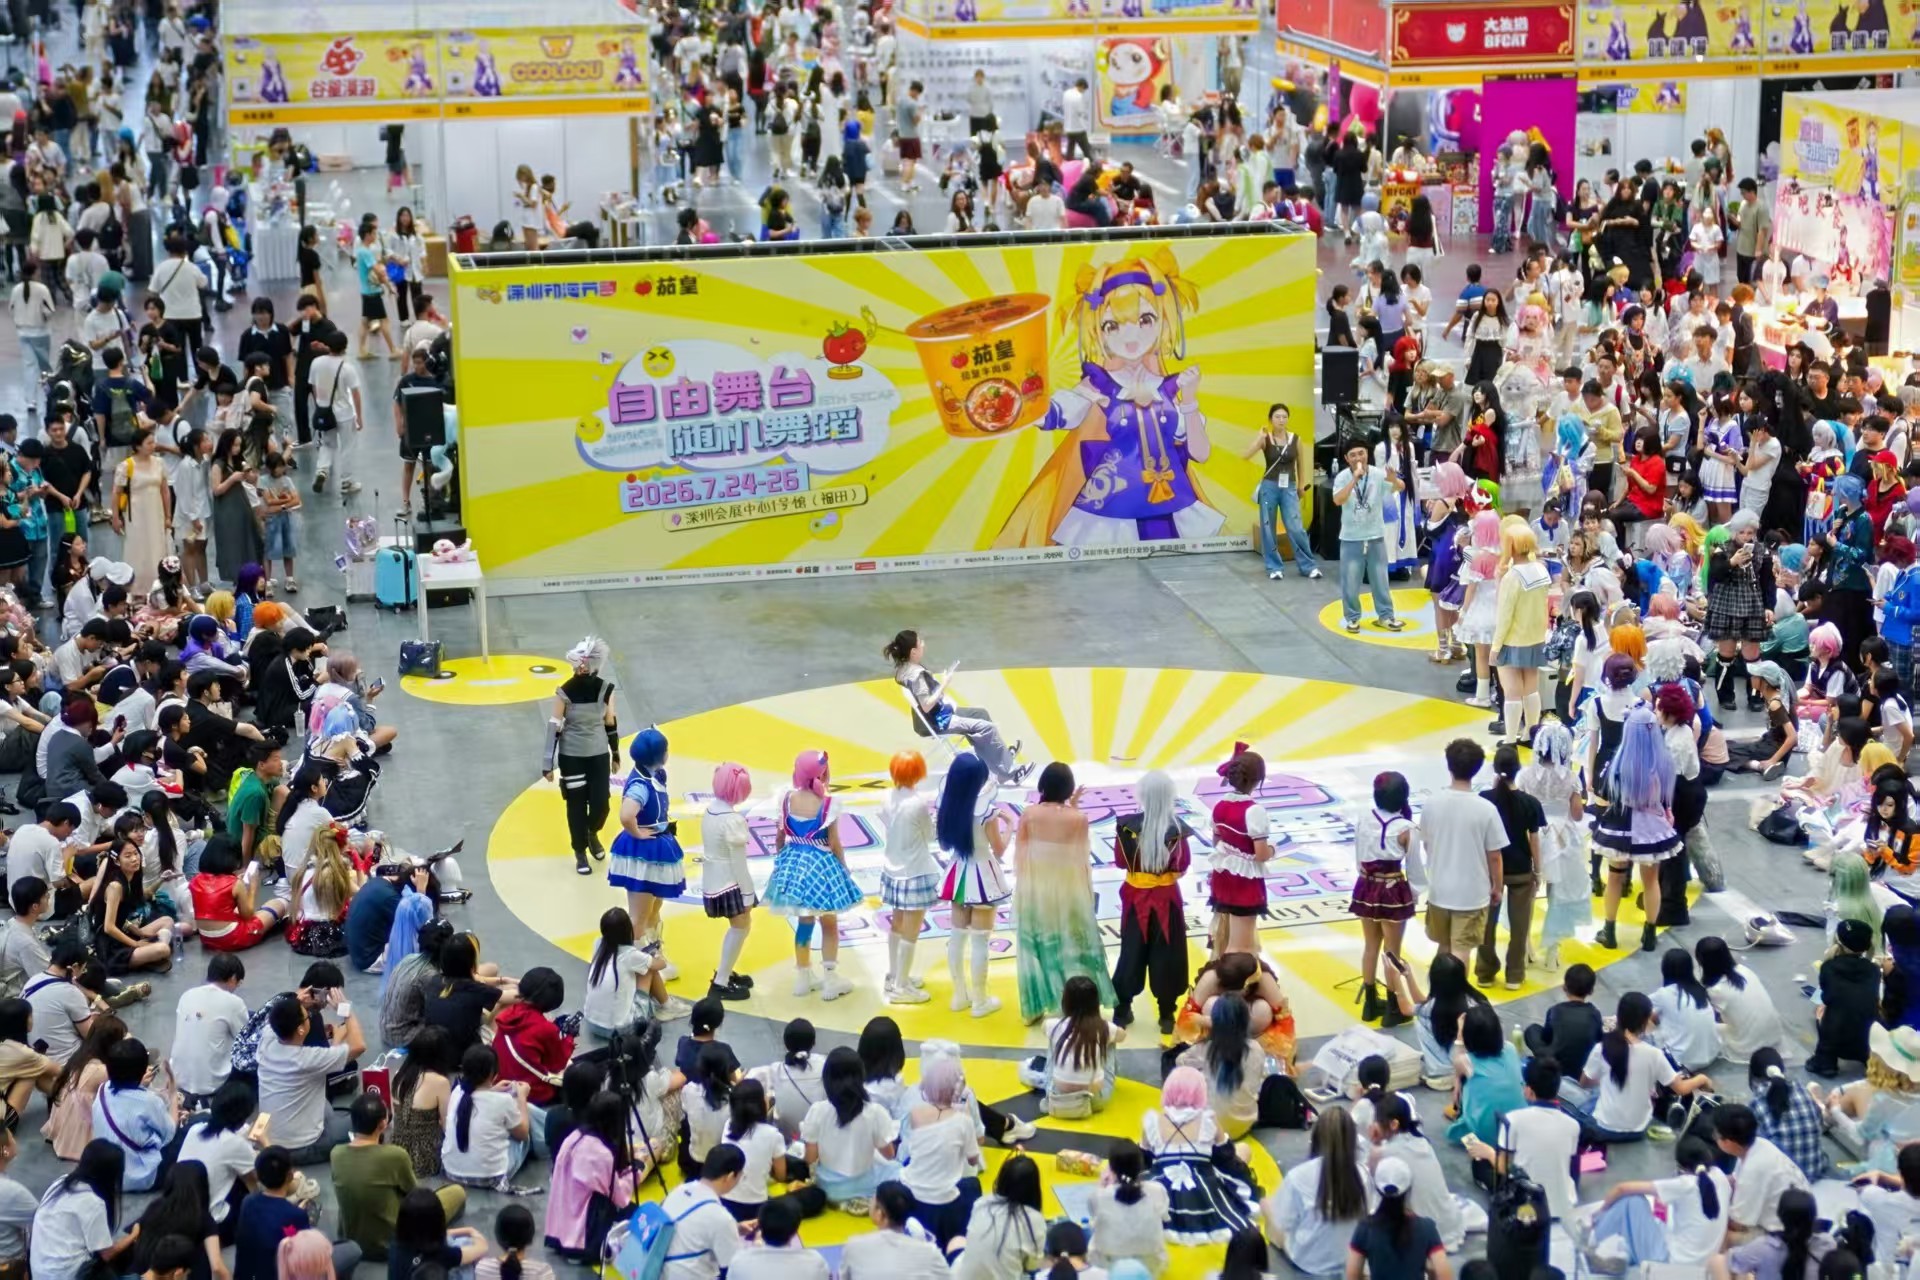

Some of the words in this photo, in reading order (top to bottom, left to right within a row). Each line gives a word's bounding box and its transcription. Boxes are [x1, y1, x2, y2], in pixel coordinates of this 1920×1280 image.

[1484, 33, 1529, 48] BFCAT
[512, 61, 603, 82] COOLDOU
[656, 275, 699, 296] 茄皇
[972, 340, 1015, 366] 茄皇
[608, 366, 816, 424] 自由舞台
[666, 406, 863, 459] 随机舞蹈
[627, 467, 801, 508] 2026.7.24-26
